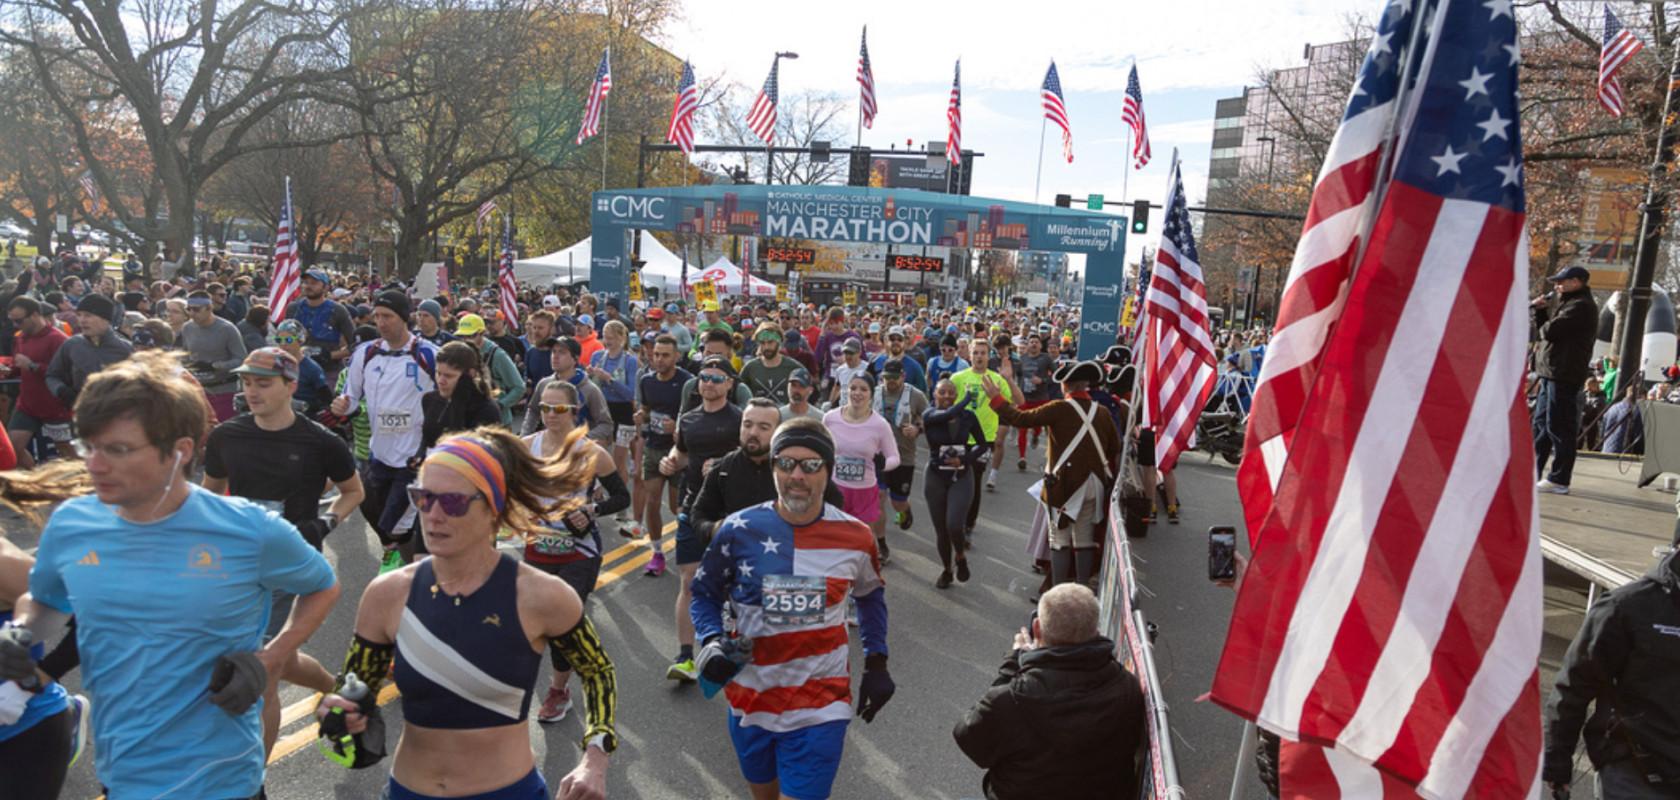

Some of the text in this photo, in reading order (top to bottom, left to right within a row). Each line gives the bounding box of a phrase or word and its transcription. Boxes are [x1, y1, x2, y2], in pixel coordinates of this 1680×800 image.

[774, 191, 883, 203] CATHOLIC MEDICAL CENTER
[611, 195, 664, 219] CMC
[767, 201, 934, 221] MANCHESTER CITY
[766, 215, 932, 244] MARATHON
[1047, 223, 1110, 236] Millennium
[1061, 235, 1109, 251] Running
[1089, 321, 1115, 332] CMC
[765, 594, 822, 612] 2594
